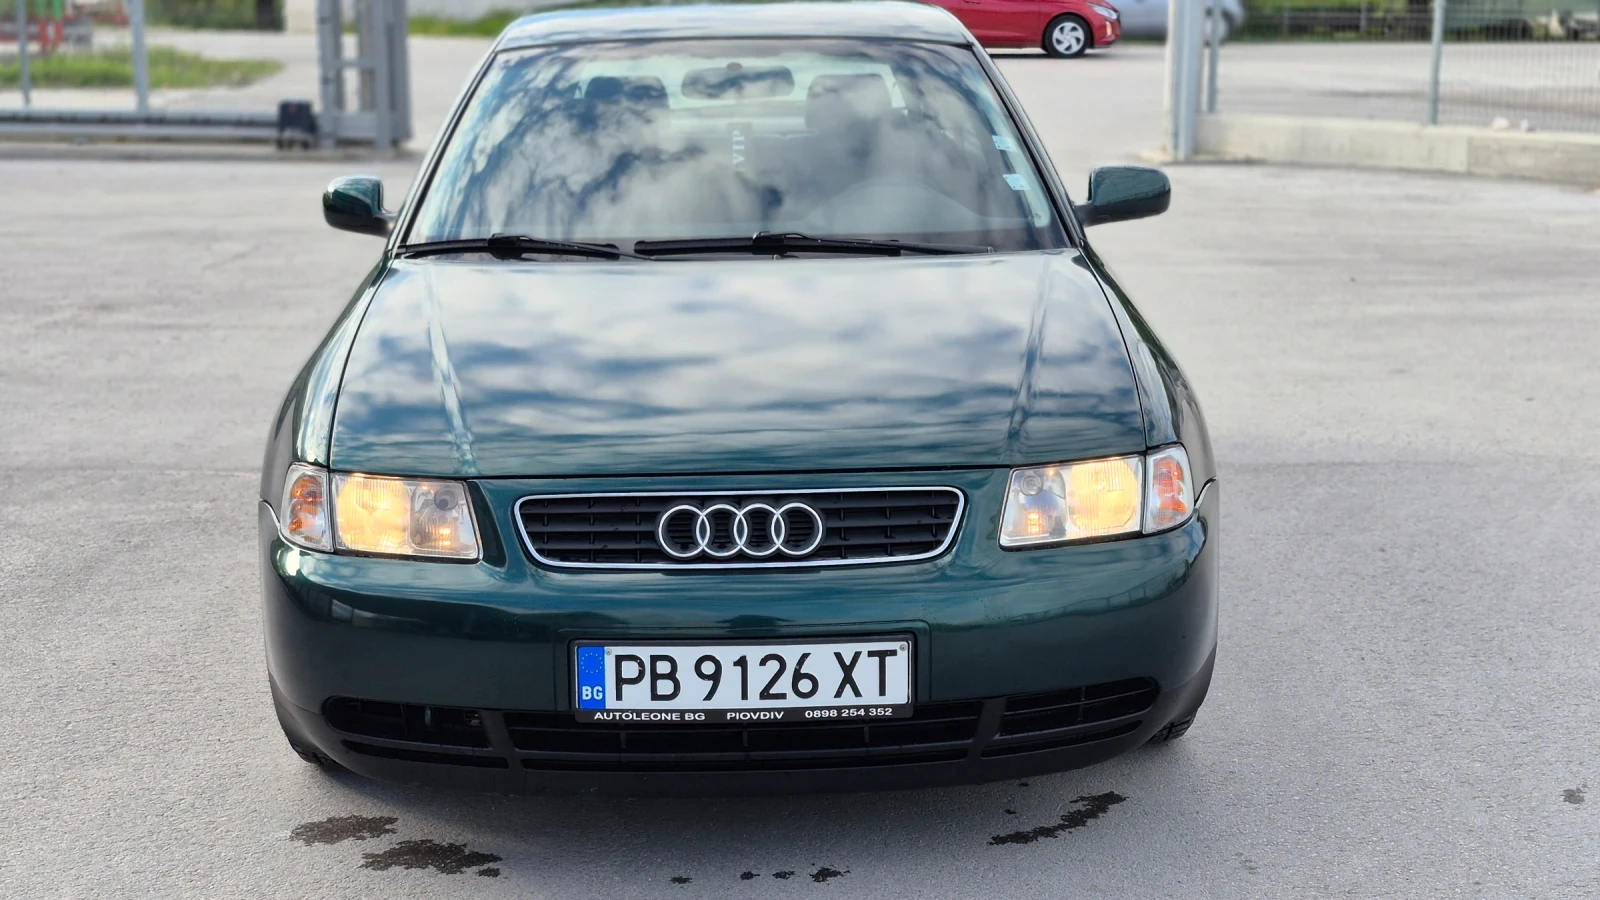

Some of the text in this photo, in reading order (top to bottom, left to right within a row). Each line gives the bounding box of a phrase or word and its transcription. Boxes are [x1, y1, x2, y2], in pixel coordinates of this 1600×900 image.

[732, 130, 745, 165] VIP
[614, 649, 898, 701] PB 9126 XT
[582, 685, 603, 700] BG
[684, 711, 706, 721] BG
[804, 708, 838, 718] 0898
[841, 707, 866, 717] 254
[868, 706, 893, 716] 352
